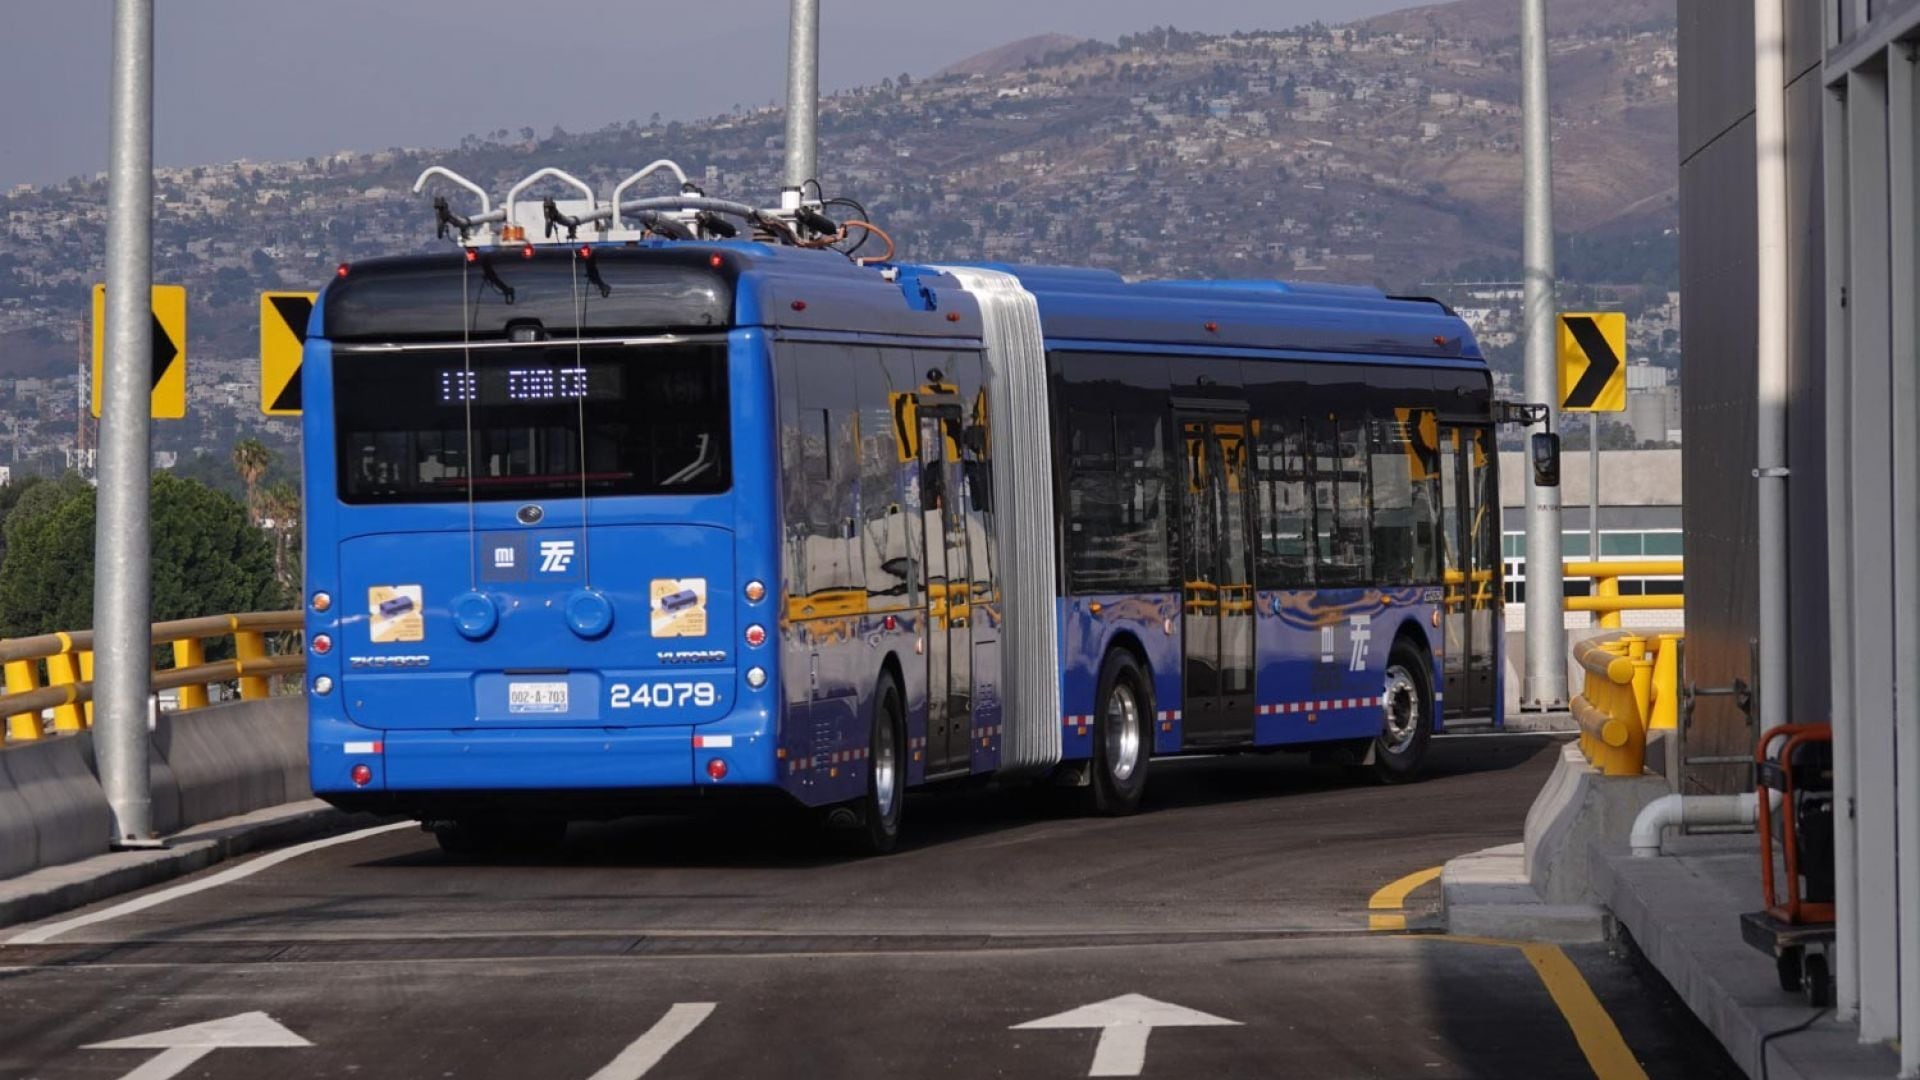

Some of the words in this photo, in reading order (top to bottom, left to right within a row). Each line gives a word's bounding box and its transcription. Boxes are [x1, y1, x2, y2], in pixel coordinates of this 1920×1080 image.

[656, 650, 727, 664] YUTONG
[511, 690, 566, 703] 002-A-703
[610, 682, 715, 708] 24079
